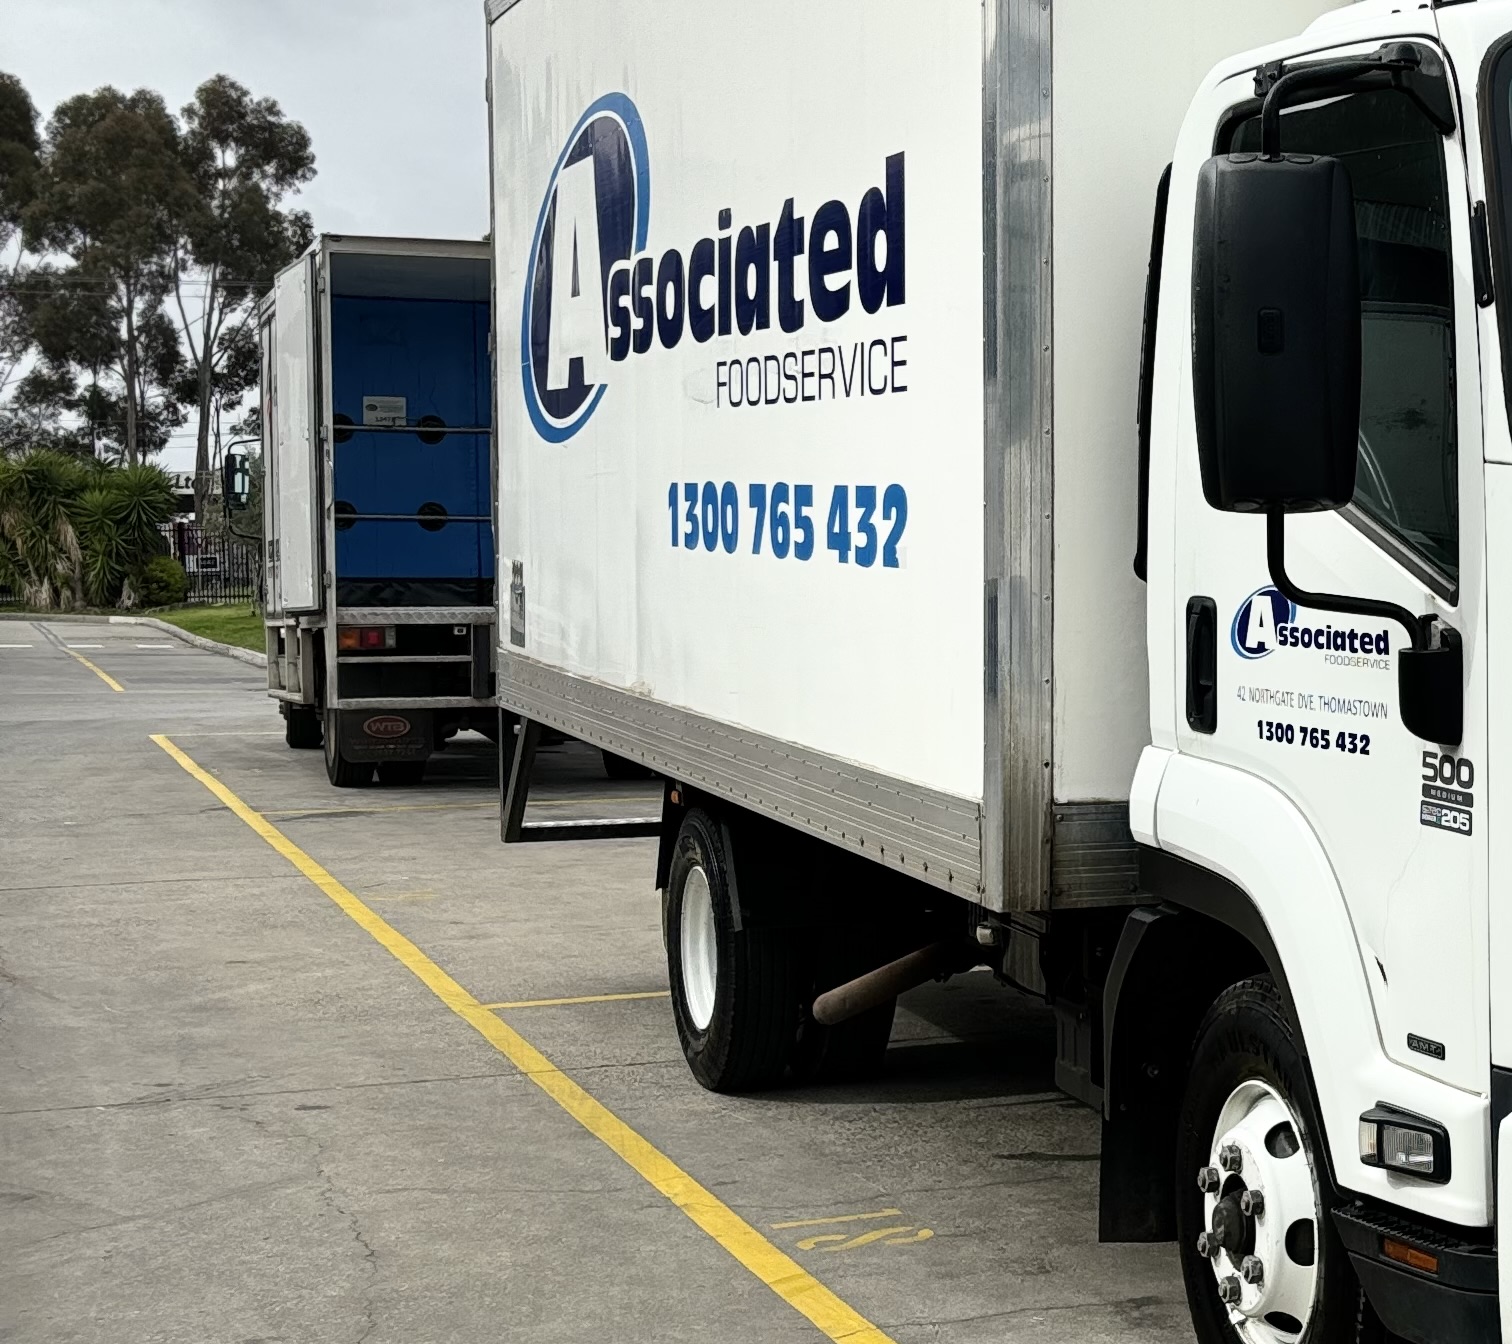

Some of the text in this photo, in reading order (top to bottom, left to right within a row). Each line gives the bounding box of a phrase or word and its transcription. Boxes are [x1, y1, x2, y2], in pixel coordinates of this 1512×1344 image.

[547, 150, 906, 392] Associated
[716, 335, 908, 408] FOODSERVICE
[668, 481, 908, 568] 1300 765 432
[1244, 594, 1390, 656] Associated
[1324, 653, 1391, 671] FOODSERVICE
[1236, 685, 1247, 702] 42
[1248, 687, 1295, 709] NORTHGATE
[1318, 695, 1389, 720] THOMASTOWN
[1257, 719, 1371, 756] 1300 765 432
[1421, 750, 1475, 790] 500
[1440, 808, 1470, 831] 205
